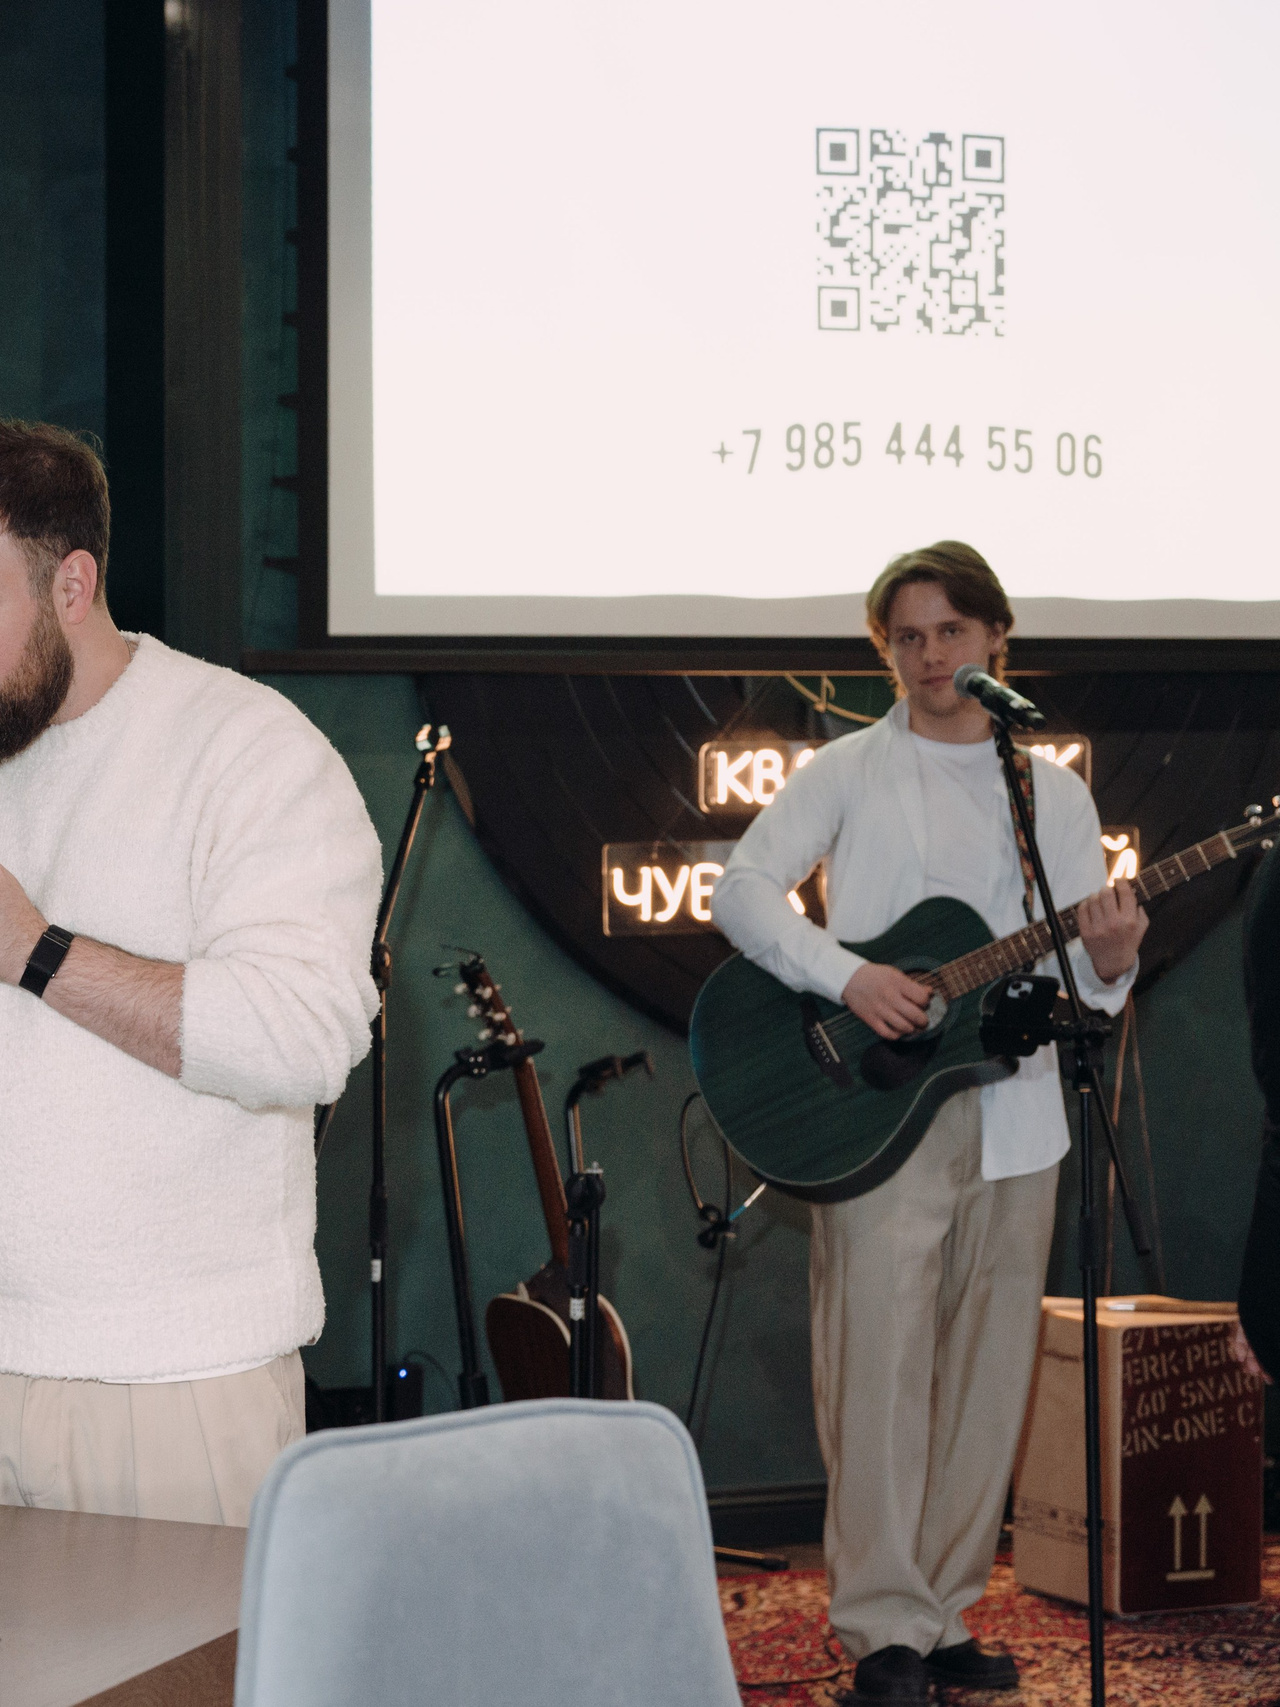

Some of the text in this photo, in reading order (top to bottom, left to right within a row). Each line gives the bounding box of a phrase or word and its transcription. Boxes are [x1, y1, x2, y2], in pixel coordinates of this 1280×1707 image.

[712, 421, 1103, 479] +7 985 444 55 06
[715, 747, 815, 806] КВ
